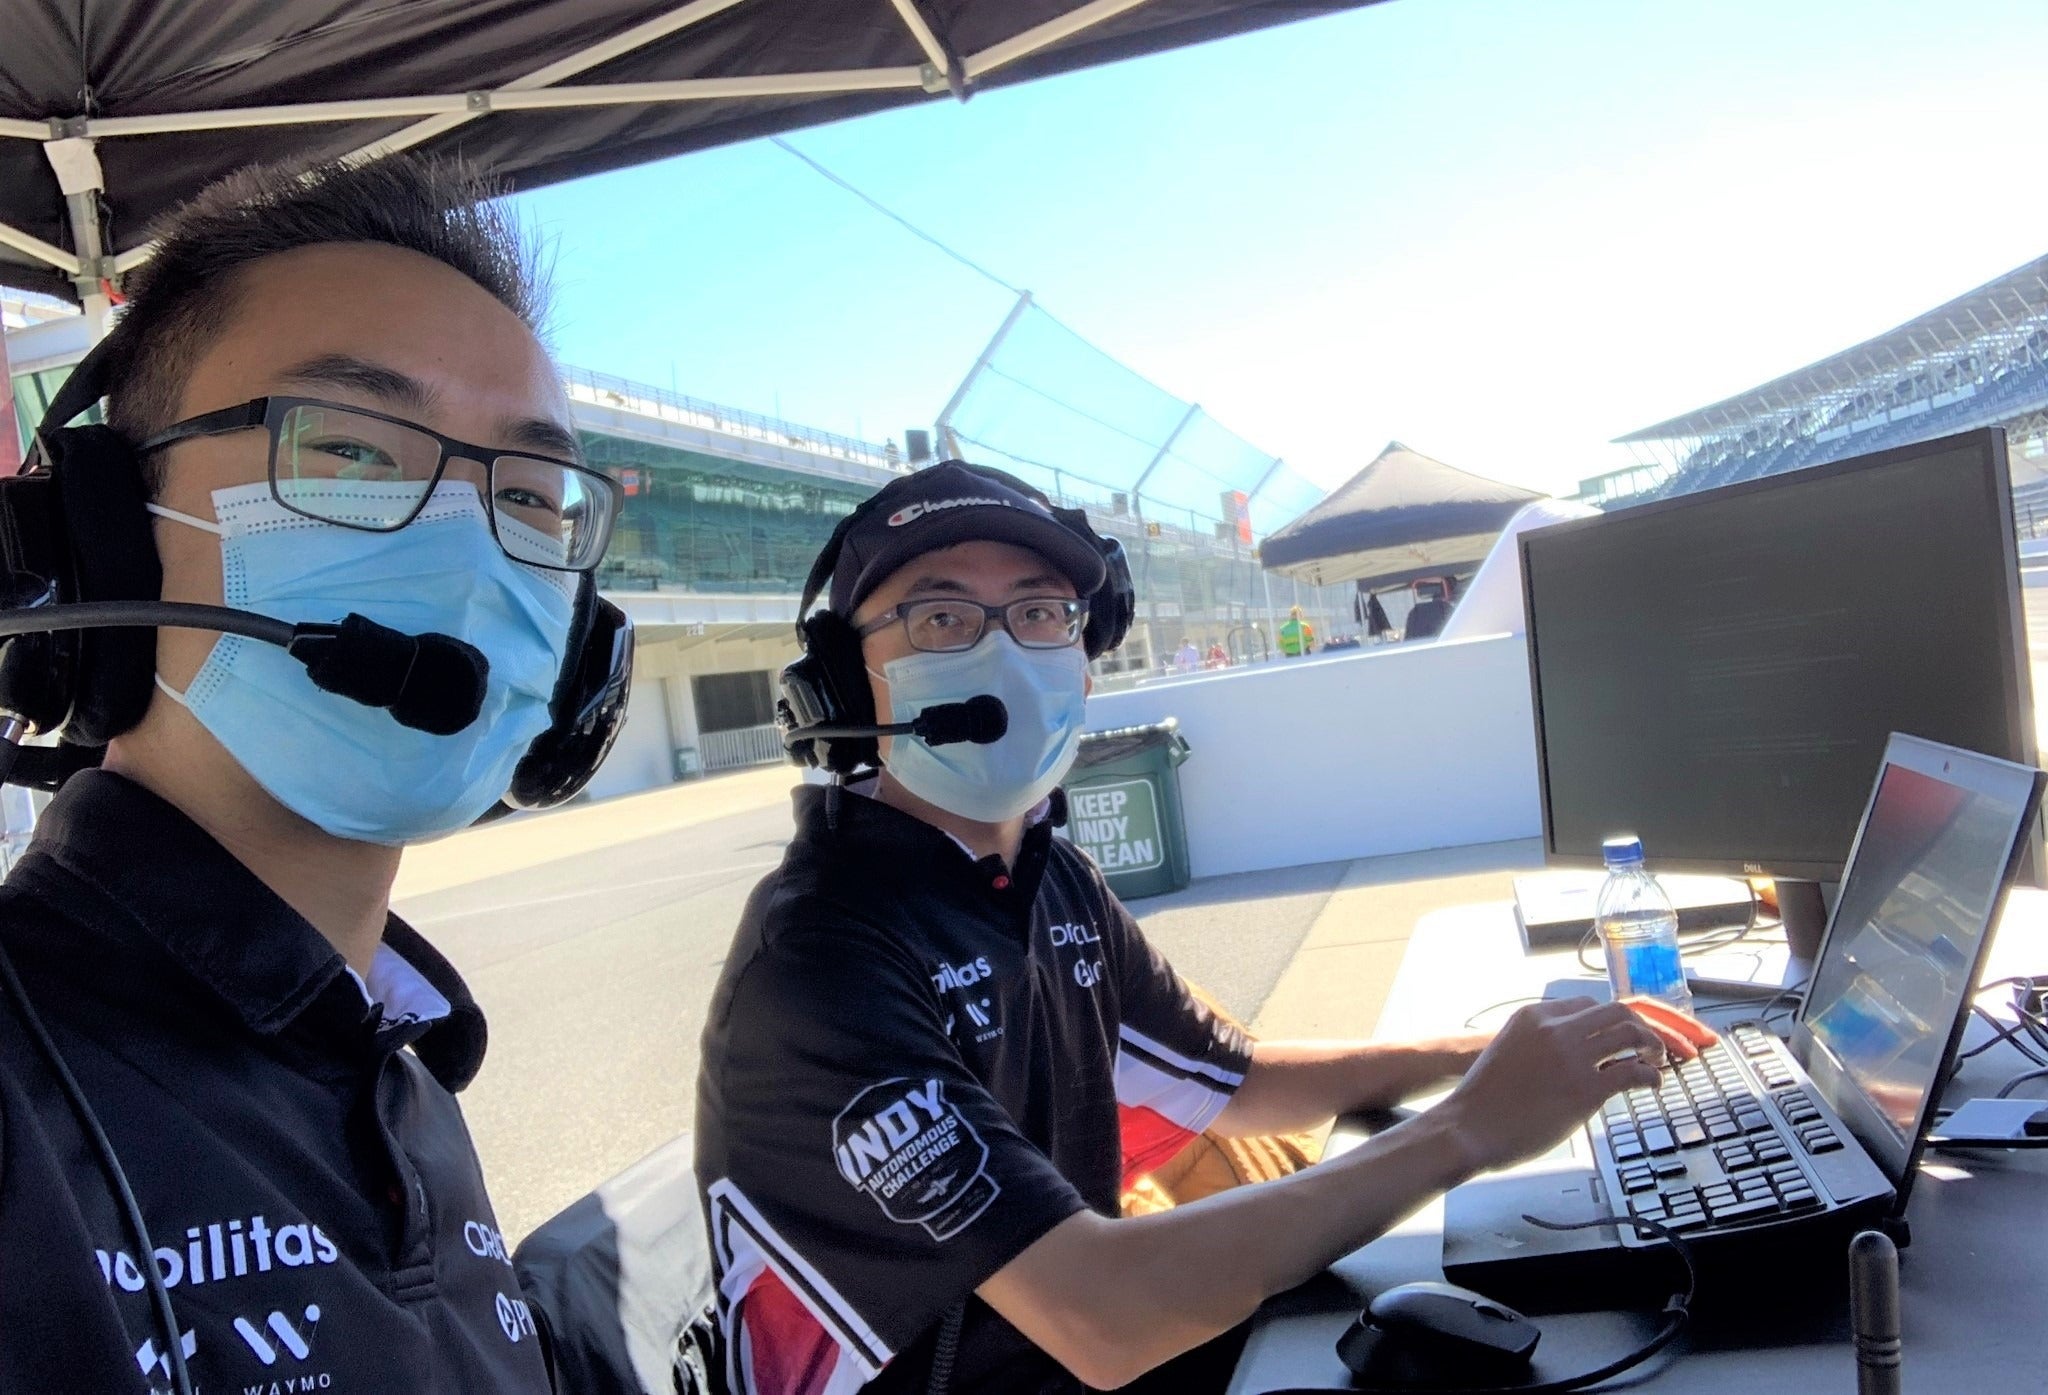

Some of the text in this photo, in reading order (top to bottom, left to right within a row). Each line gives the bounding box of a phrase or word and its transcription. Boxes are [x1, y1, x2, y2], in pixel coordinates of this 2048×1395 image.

[1073, 790, 1127, 818] KEEP
[1077, 816, 1128, 844] INDY
[1743, 862, 1763, 873] DELL
[837, 1078, 944, 1187] INDY
[867, 1114, 959, 1192] AUTONOMOUS
[880, 1130, 961, 1200] CHALLENGE
[95, 1215, 338, 1292] obilitas
[243, 1372, 331, 1395] WAYMO
